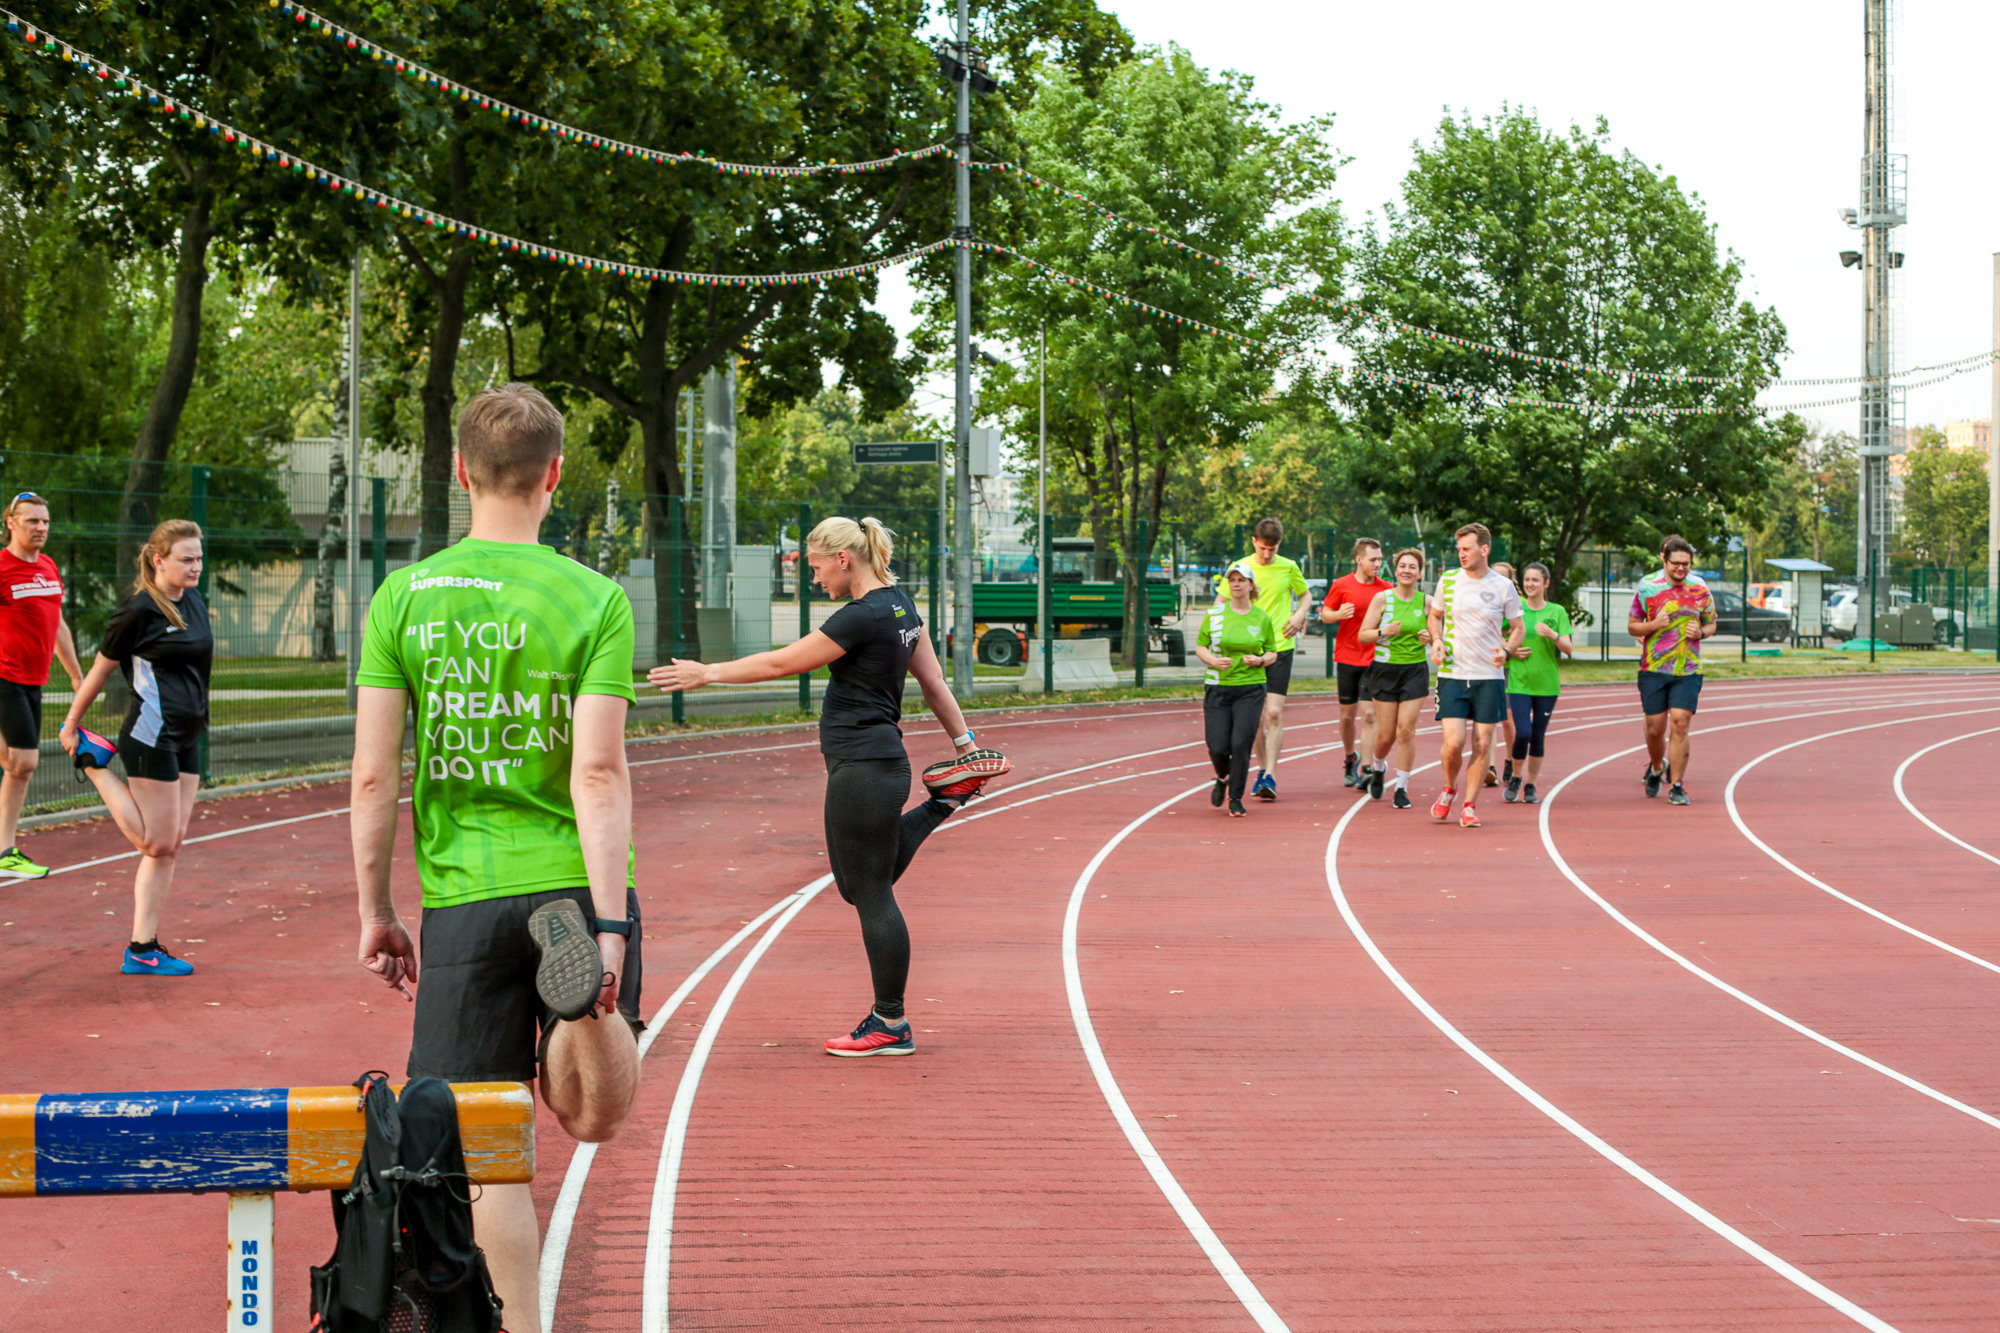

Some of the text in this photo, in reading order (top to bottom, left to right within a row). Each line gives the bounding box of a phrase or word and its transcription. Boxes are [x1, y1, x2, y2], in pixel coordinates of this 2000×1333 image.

[409, 576, 504, 592] SUPERSPORT
[454, 620, 526, 651] YOU
[423, 656, 491, 684] CAN
[527, 669, 549, 680] Walt
[427, 690, 541, 720] DREAM
[425, 723, 569, 754] YOU CAN
[429, 755, 475, 781] DO
[242, 1240, 258, 1326] MONDO
